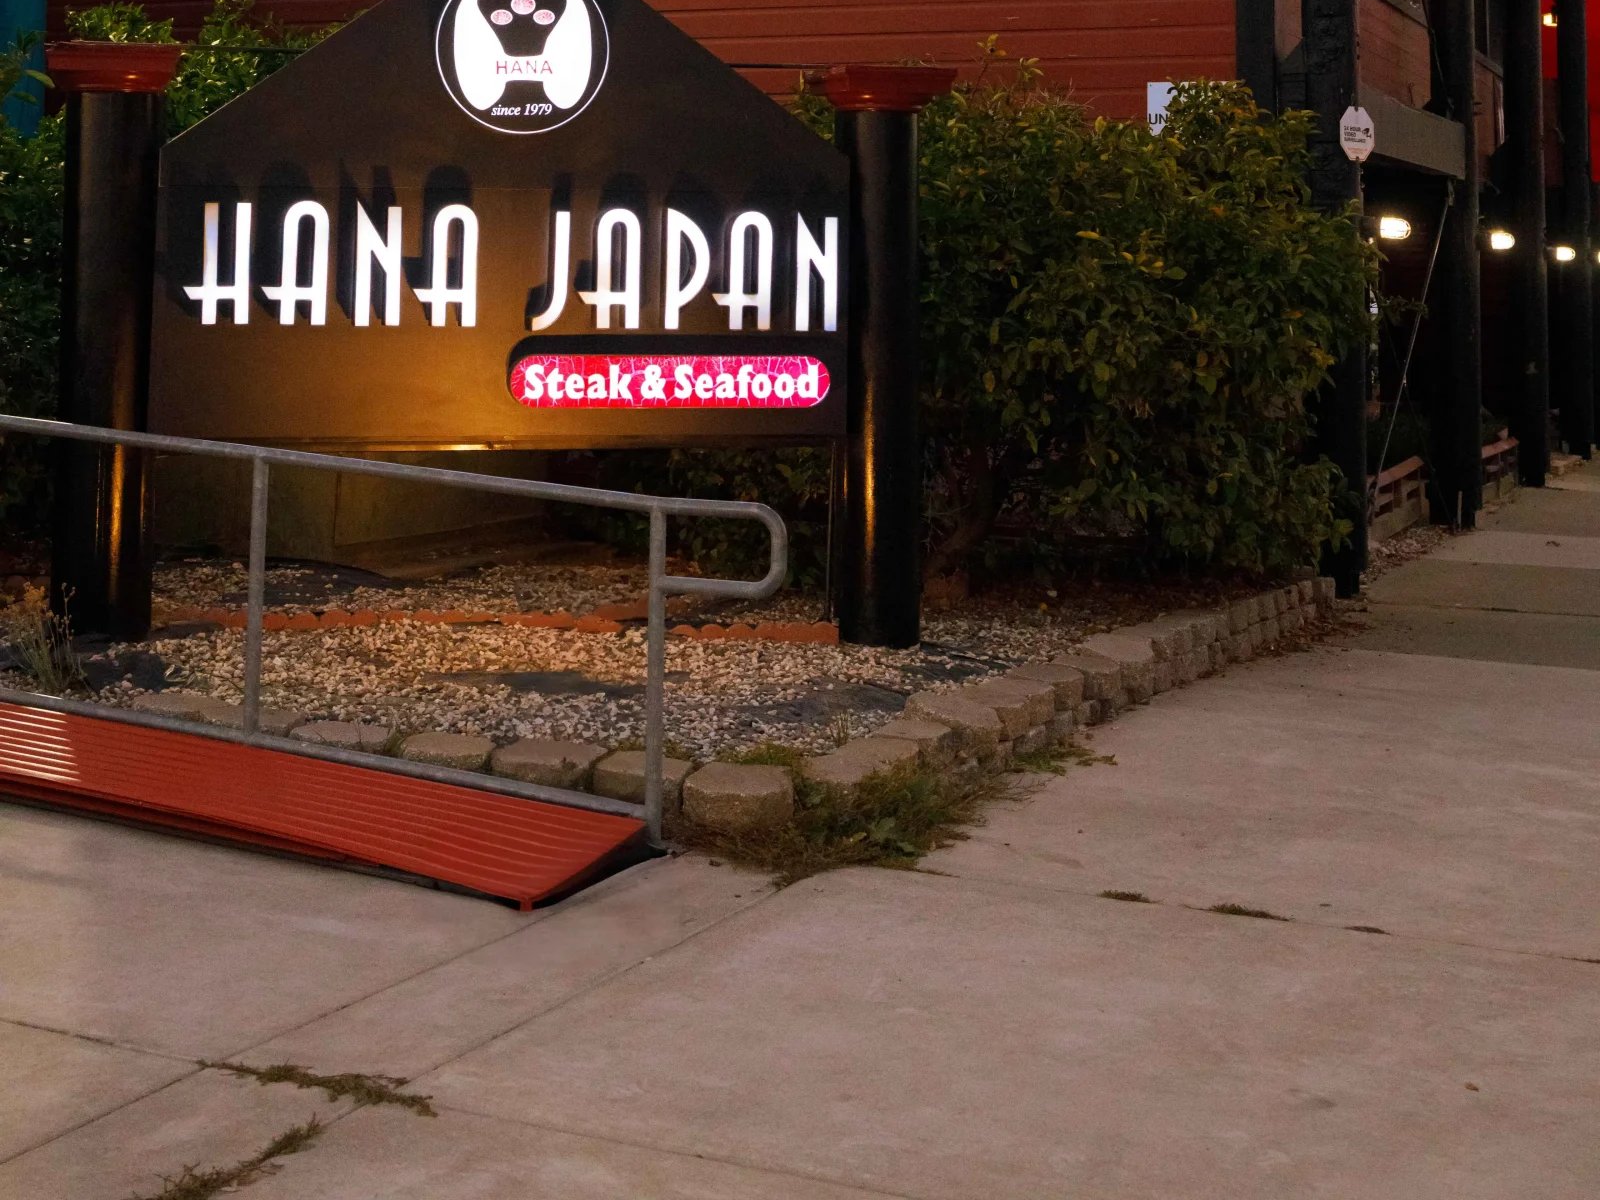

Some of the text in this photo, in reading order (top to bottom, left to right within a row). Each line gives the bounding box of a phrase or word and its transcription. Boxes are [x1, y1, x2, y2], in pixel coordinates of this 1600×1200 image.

[496, 60, 553, 74] HANA
[491, 103, 553, 116] since 1979
[182, 200, 839, 331] HANA JAPAN
[524, 363, 818, 399] Steak & Seafood
